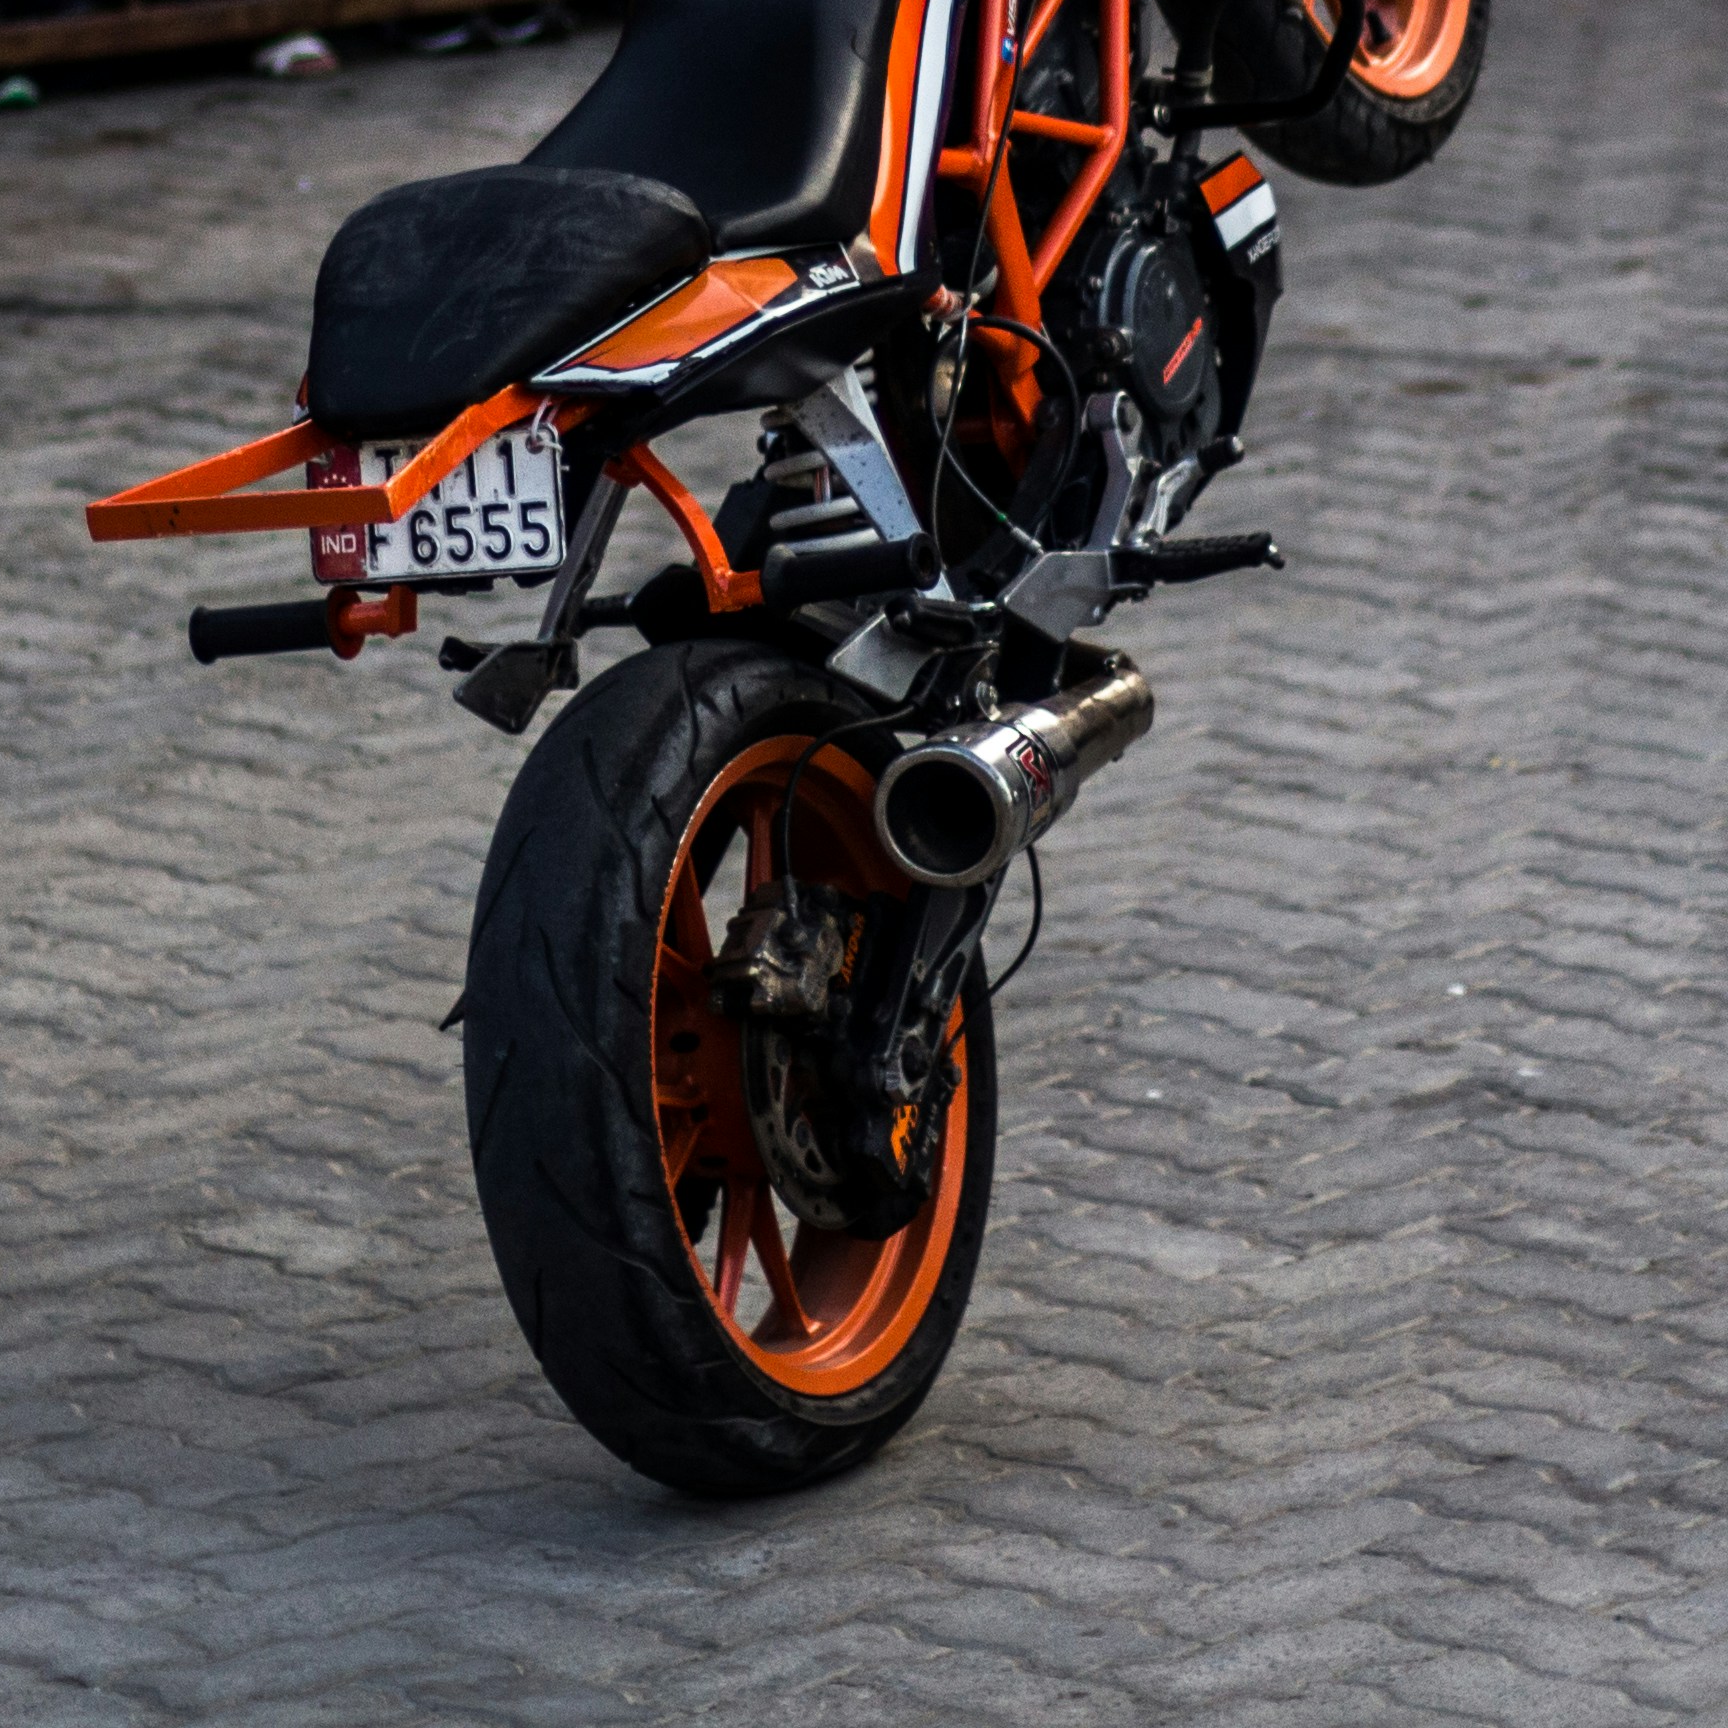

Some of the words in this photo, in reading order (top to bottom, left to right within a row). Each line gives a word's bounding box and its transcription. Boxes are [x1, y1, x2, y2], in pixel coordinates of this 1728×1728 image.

[808, 262, 850, 289] KTM
[321, 533, 358, 556] IND
[408, 500, 551, 566] 6555
